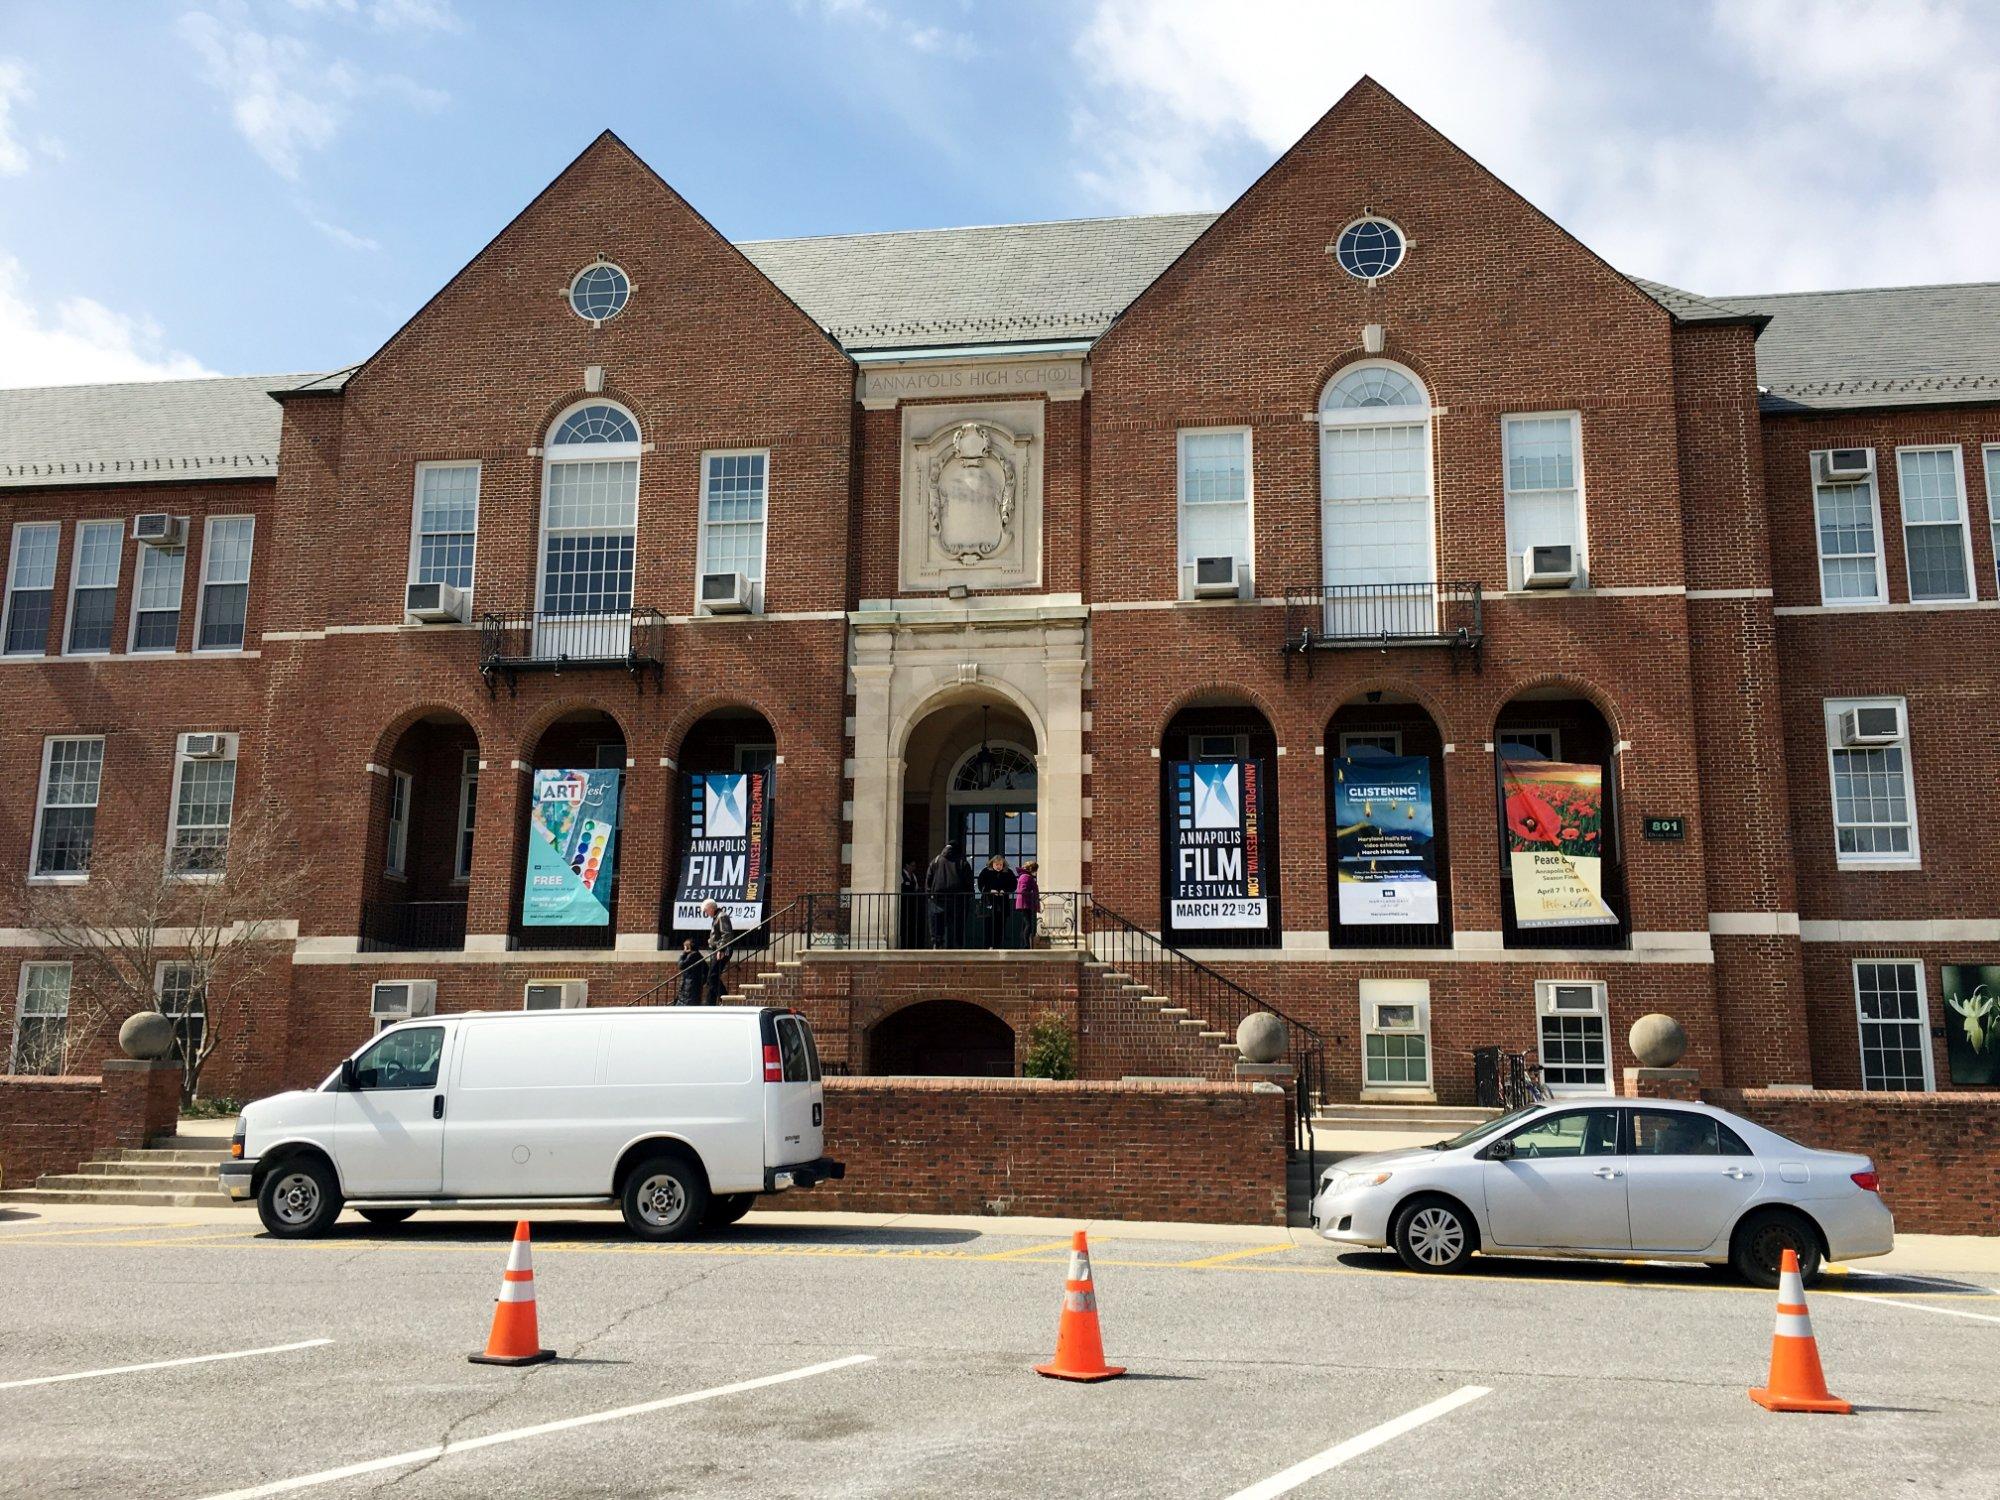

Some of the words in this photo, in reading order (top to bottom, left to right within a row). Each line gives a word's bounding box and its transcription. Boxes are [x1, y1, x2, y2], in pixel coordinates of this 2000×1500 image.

[872, 371, 962, 391] ANNAPOLIS
[970, 370, 1008, 386] HIGH
[1015, 367, 1076, 384] SCHOOL
[543, 784, 579, 798] ART
[1348, 786, 1417, 797] GLISTENING
[1245, 763, 1259, 896] ANNAPOLISFILMFESTIVAL.COM
[1652, 821, 1678, 831] 801
[1179, 831, 1241, 844] ANNAPOLIS
[690, 839, 747, 853] ANNAPOLIS
[1179, 848, 1242, 881] FILM
[1534, 855, 1560, 865] Peace
[686, 854, 746, 887] FILM
[533, 875, 563, 885] FREE
[683, 888, 742, 900] FESTIVAL
[1179, 884, 1242, 897] FESTIVAL
[743, 905, 756, 918] 25
[1176, 904, 1218, 917] MARCH
[1222, 903, 1236, 916] 22
[1247, 903, 1261, 916] 25
